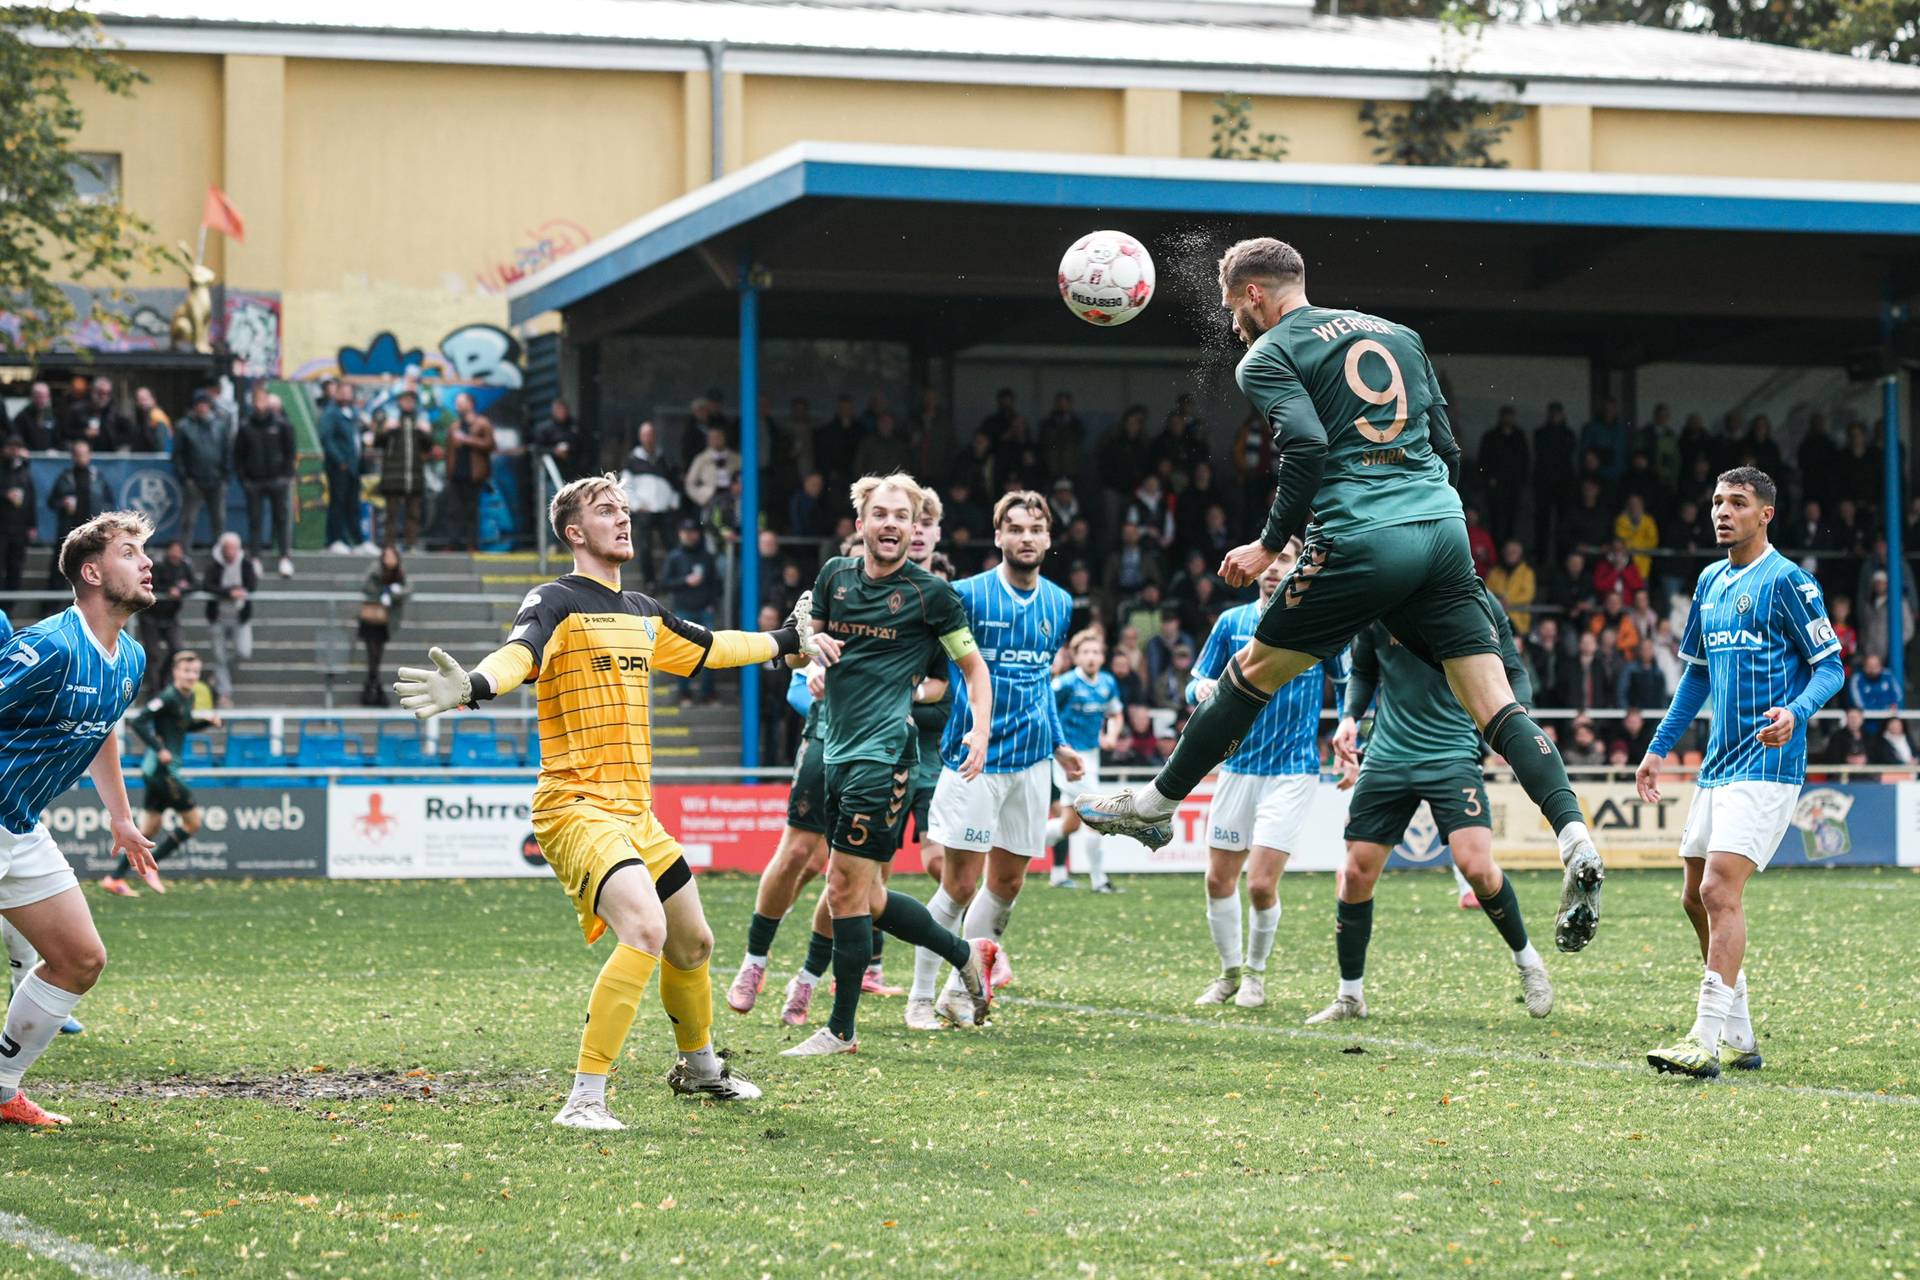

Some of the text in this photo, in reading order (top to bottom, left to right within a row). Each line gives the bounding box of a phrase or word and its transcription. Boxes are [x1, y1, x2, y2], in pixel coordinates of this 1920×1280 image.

[1311, 316, 1396, 343] WERDER
[1344, 339, 1408, 444] 9
[828, 621, 897, 640] MATTHÄI
[1708, 629, 1763, 646] DRVN
[235, 793, 305, 831] web
[1462, 788, 1482, 816] 3
[847, 813, 871, 846] 5
[964, 828, 991, 844] BAB
[1214, 826, 1240, 844] BAB
